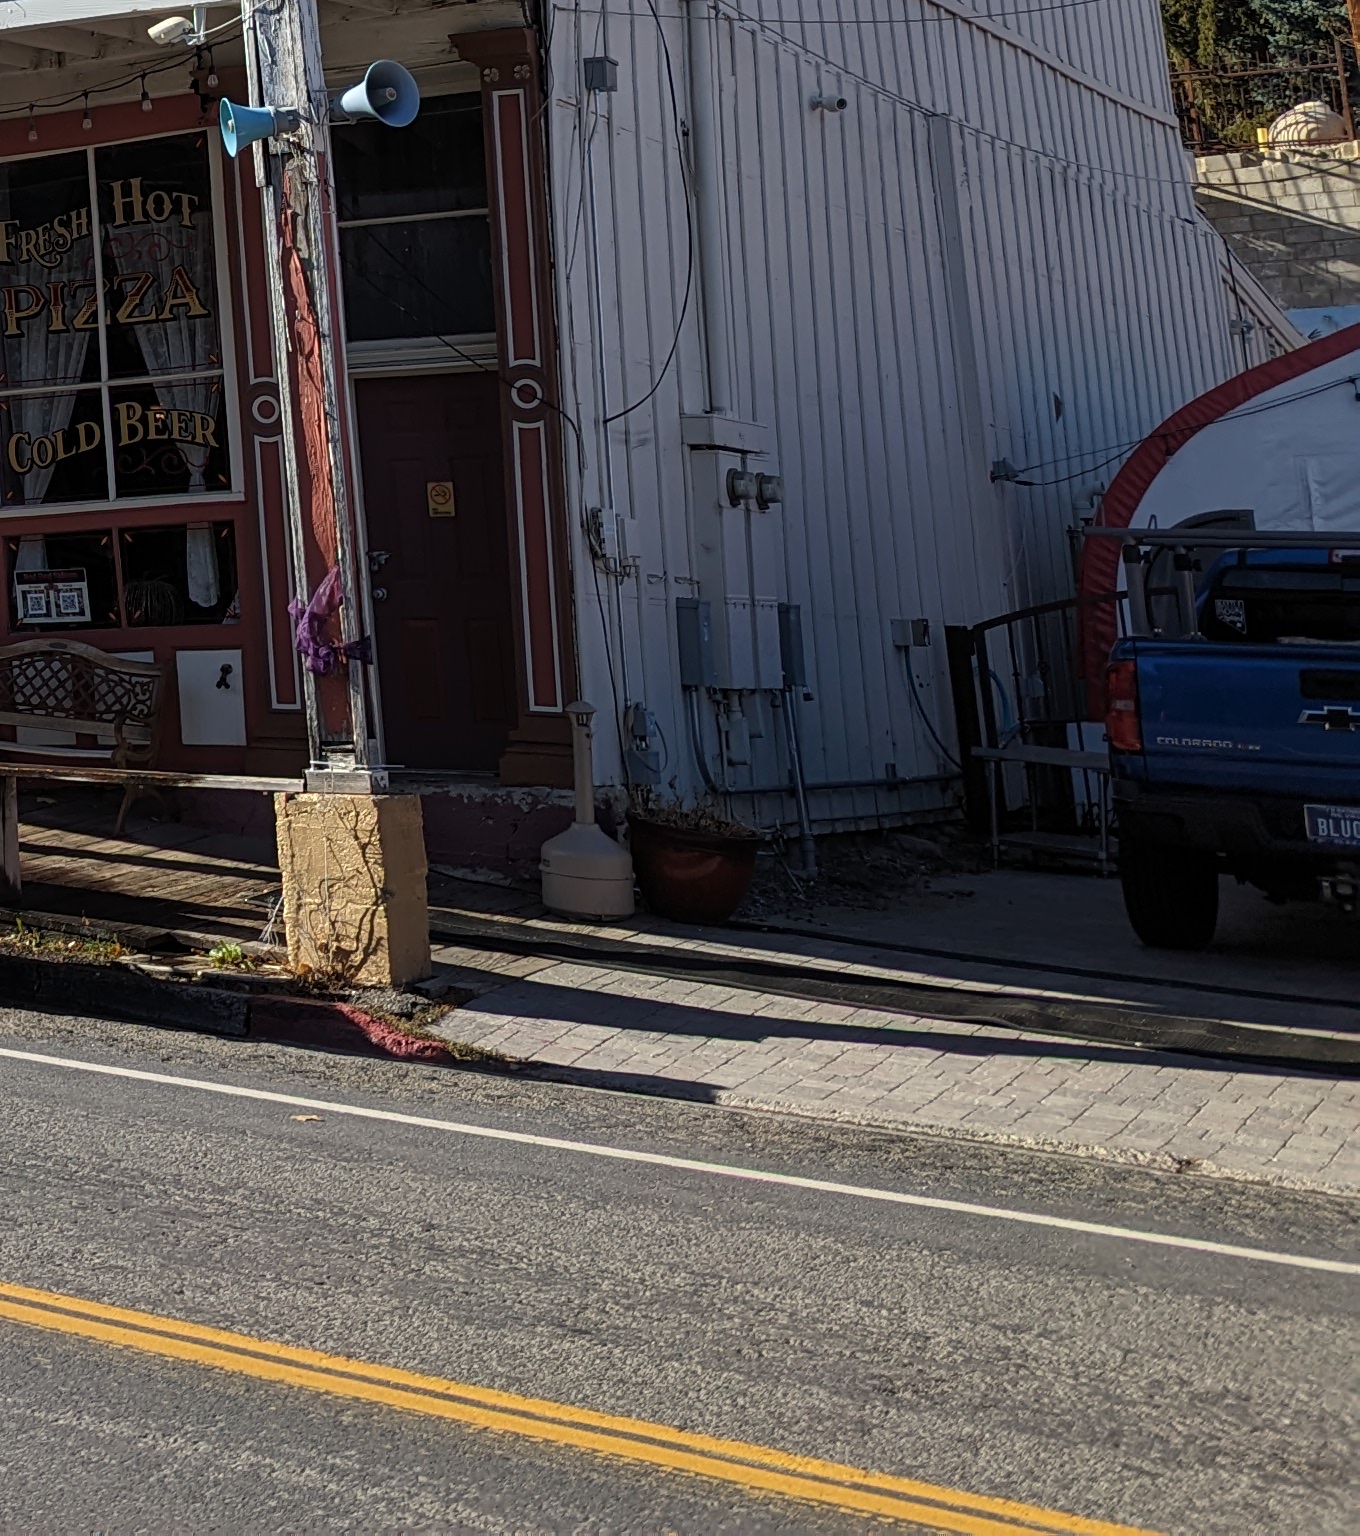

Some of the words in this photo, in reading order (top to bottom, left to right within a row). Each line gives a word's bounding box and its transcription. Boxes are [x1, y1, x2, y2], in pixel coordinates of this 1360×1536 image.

[1, 266, 210, 339] PIZZA
[8, 421, 101, 474] COLD
[114, 402, 219, 447] BEER
[1157, 736, 1232, 748] COLORADO
